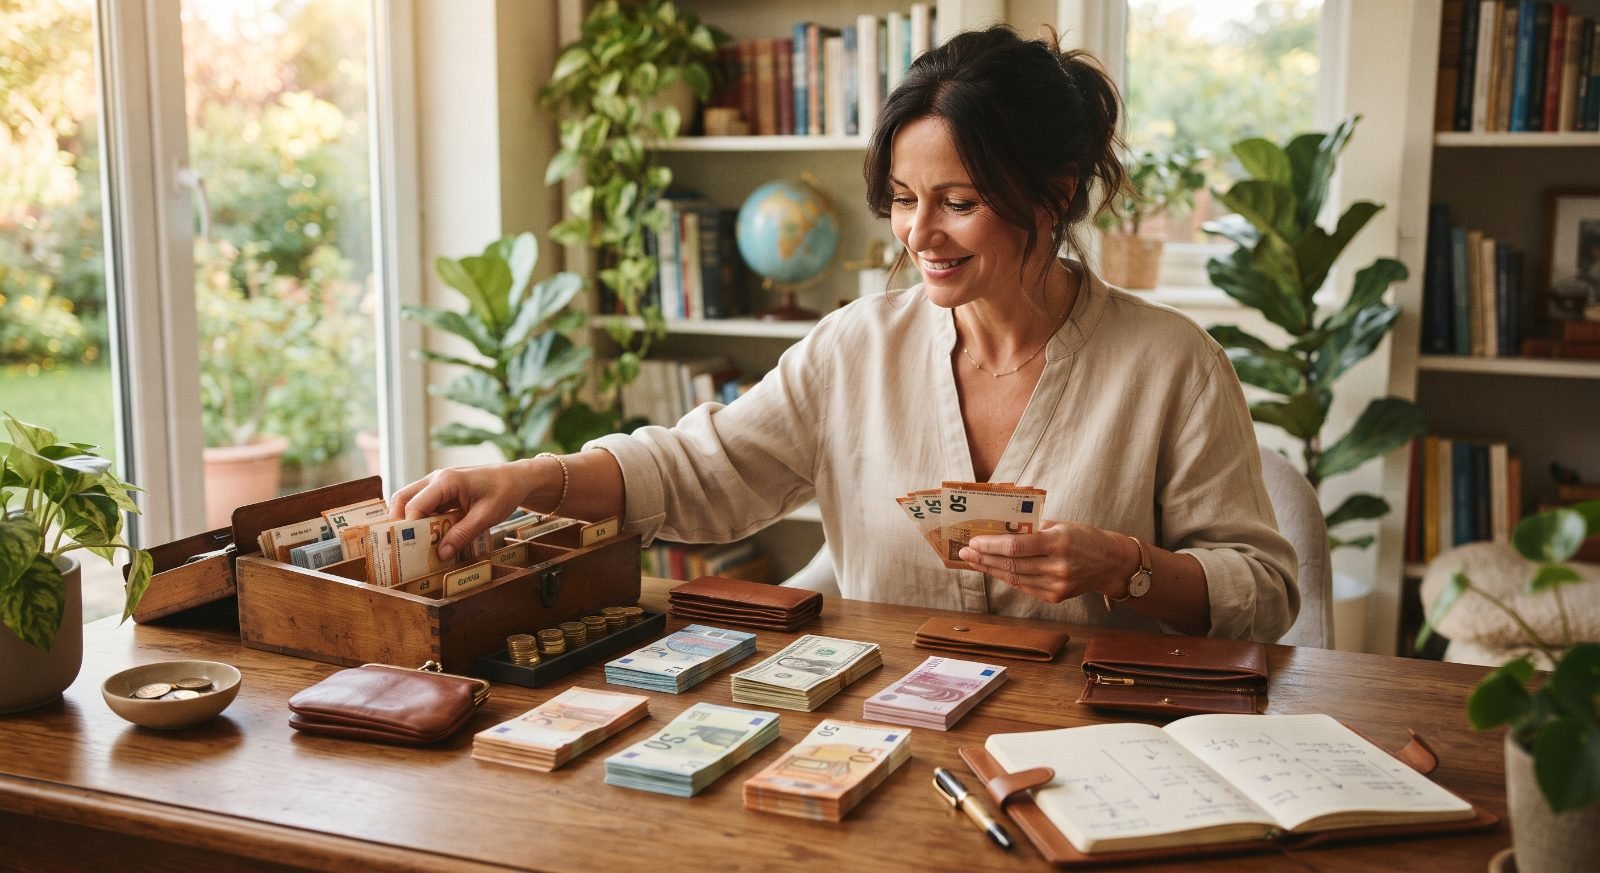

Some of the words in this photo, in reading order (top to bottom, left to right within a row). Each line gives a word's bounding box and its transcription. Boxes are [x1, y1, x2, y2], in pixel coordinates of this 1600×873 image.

[950, 495, 967, 513] 50
[1005, 521, 1034, 535] 5
[816, 725, 840, 737] 50
